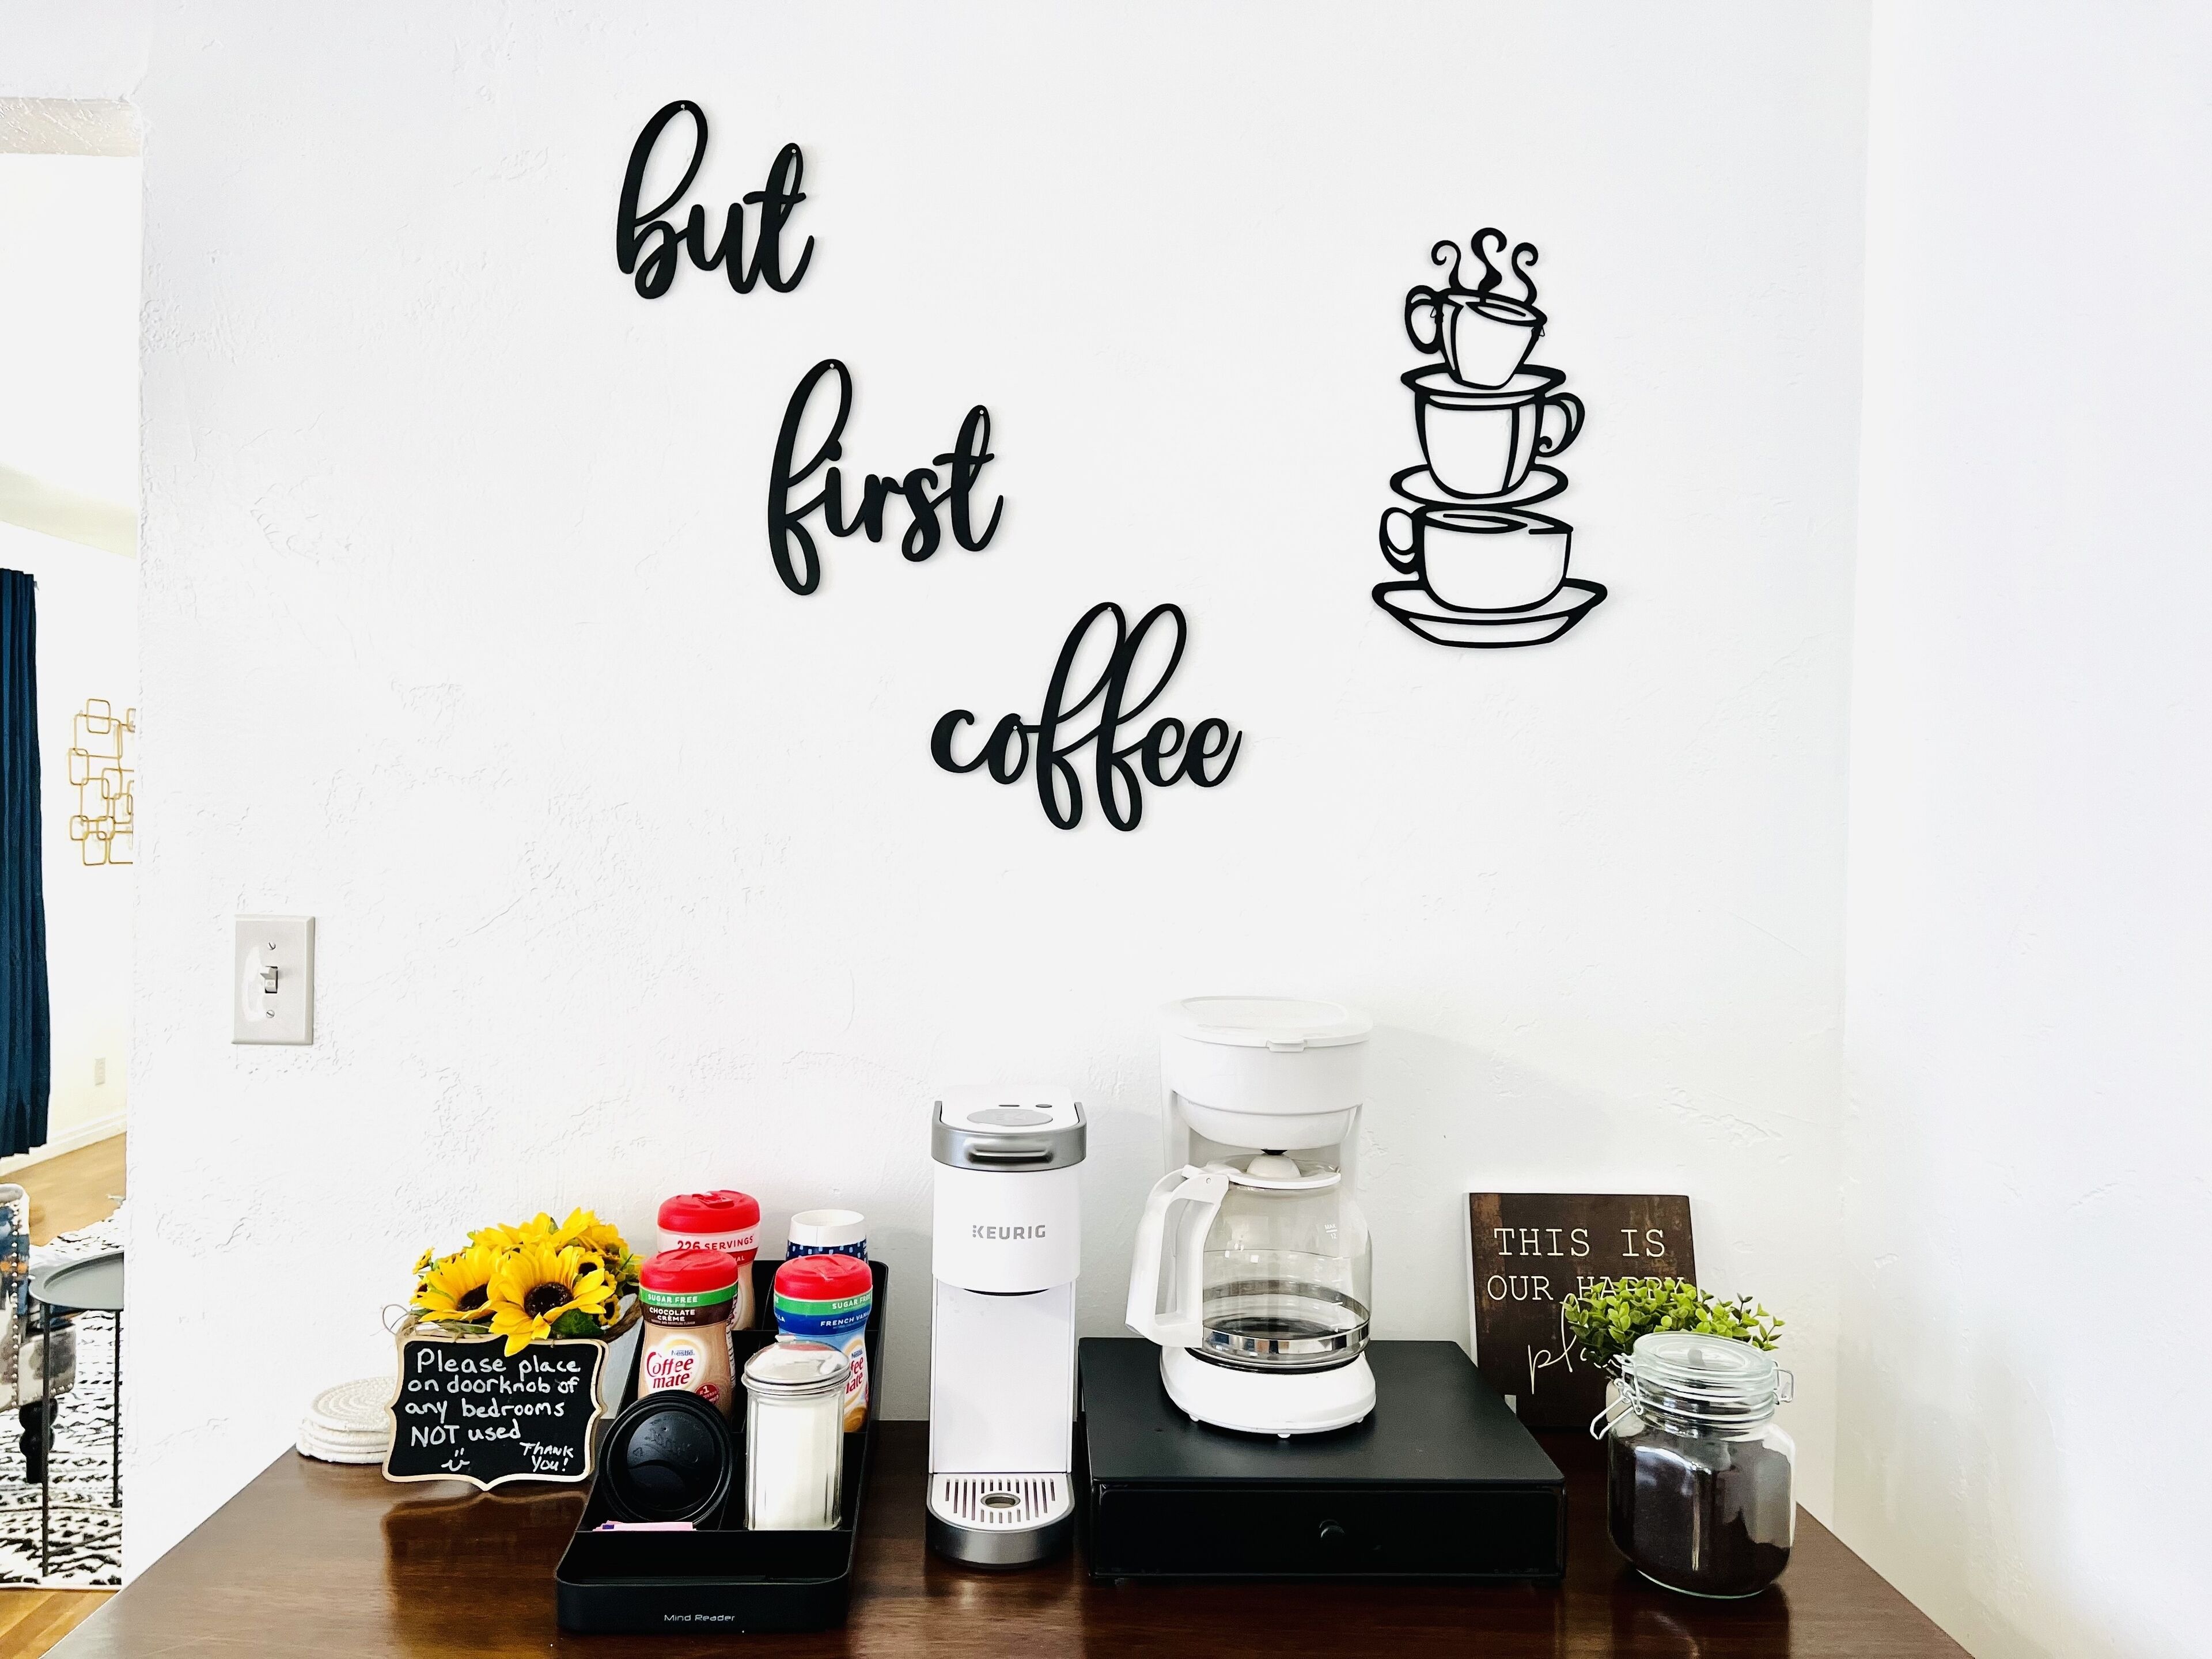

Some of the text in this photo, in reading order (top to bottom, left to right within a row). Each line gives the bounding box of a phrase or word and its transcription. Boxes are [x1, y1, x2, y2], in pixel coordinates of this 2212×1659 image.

[616, 100, 814, 299] but
[768, 359, 1003, 596] first
[931, 602, 1242, 831] coffee
[677, 1240, 700, 1250] 226
[972, 1225, 1046, 1240] KEURIG
[1494, 1228, 1665, 1257] THIS IS
[647, 1294, 672, 1303] SUGAR
[1487, 1275, 1554, 1301] OUR
[649, 1306, 695, 1316] CHOCOLATE
[832, 1299, 858, 1309] SUGAR
[821, 1317, 854, 1327] FRENCH
[417, 1348, 581, 1381] Please place
[647, 1351, 694, 1377] Coffee
[408, 1374, 579, 1395] on doorknob of
[653, 1373, 690, 1389] mate
[405, 1397, 565, 1424] any bedrooms
[411, 1418, 521, 1447] NOT used
